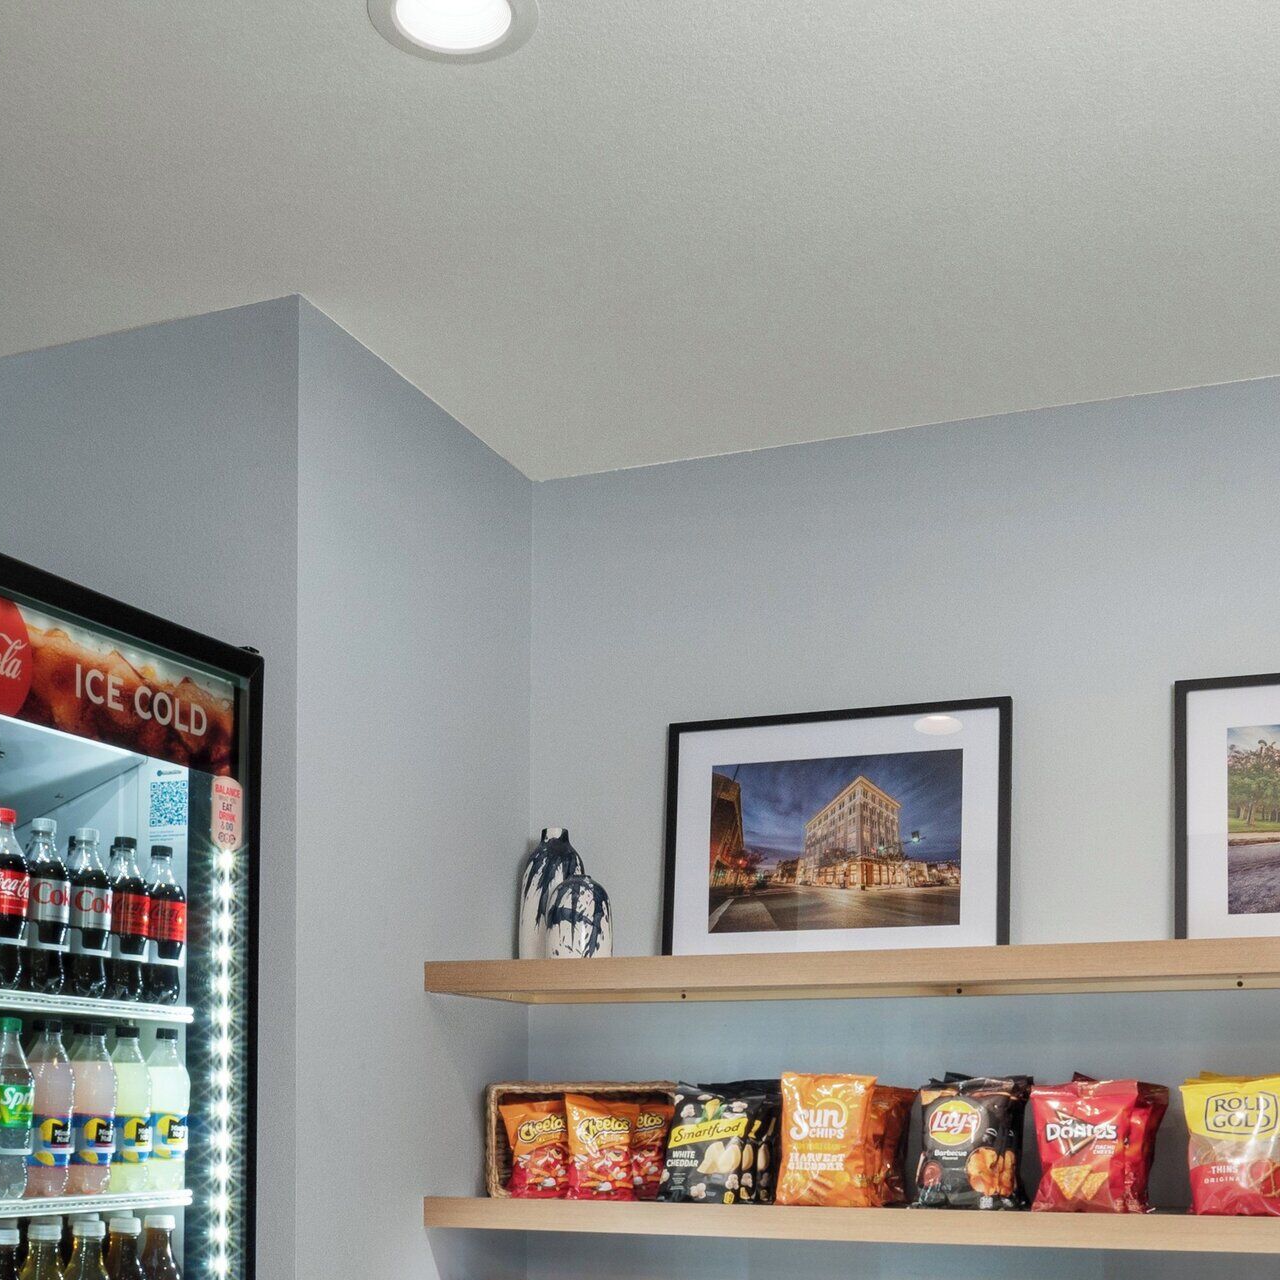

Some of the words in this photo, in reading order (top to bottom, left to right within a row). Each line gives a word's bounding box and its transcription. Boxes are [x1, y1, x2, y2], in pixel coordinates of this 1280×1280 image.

[75, 663, 124, 712] ICE
[134, 686, 208, 737] COLD
[214, 784, 241, 799] BALANCE
[75, 889, 112, 914] Cok
[1214, 1097, 1270, 1112] ROLD
[1213, 1113, 1271, 1128] GOLD
[673, 1122, 741, 1142] Smartfood
[809, 1128, 845, 1139] CHIPS
[672, 1150, 696, 1159] WHITE
[934, 1149, 968, 1157] Barbecue
[666, 1159, 699, 1167] CHEDDAR
